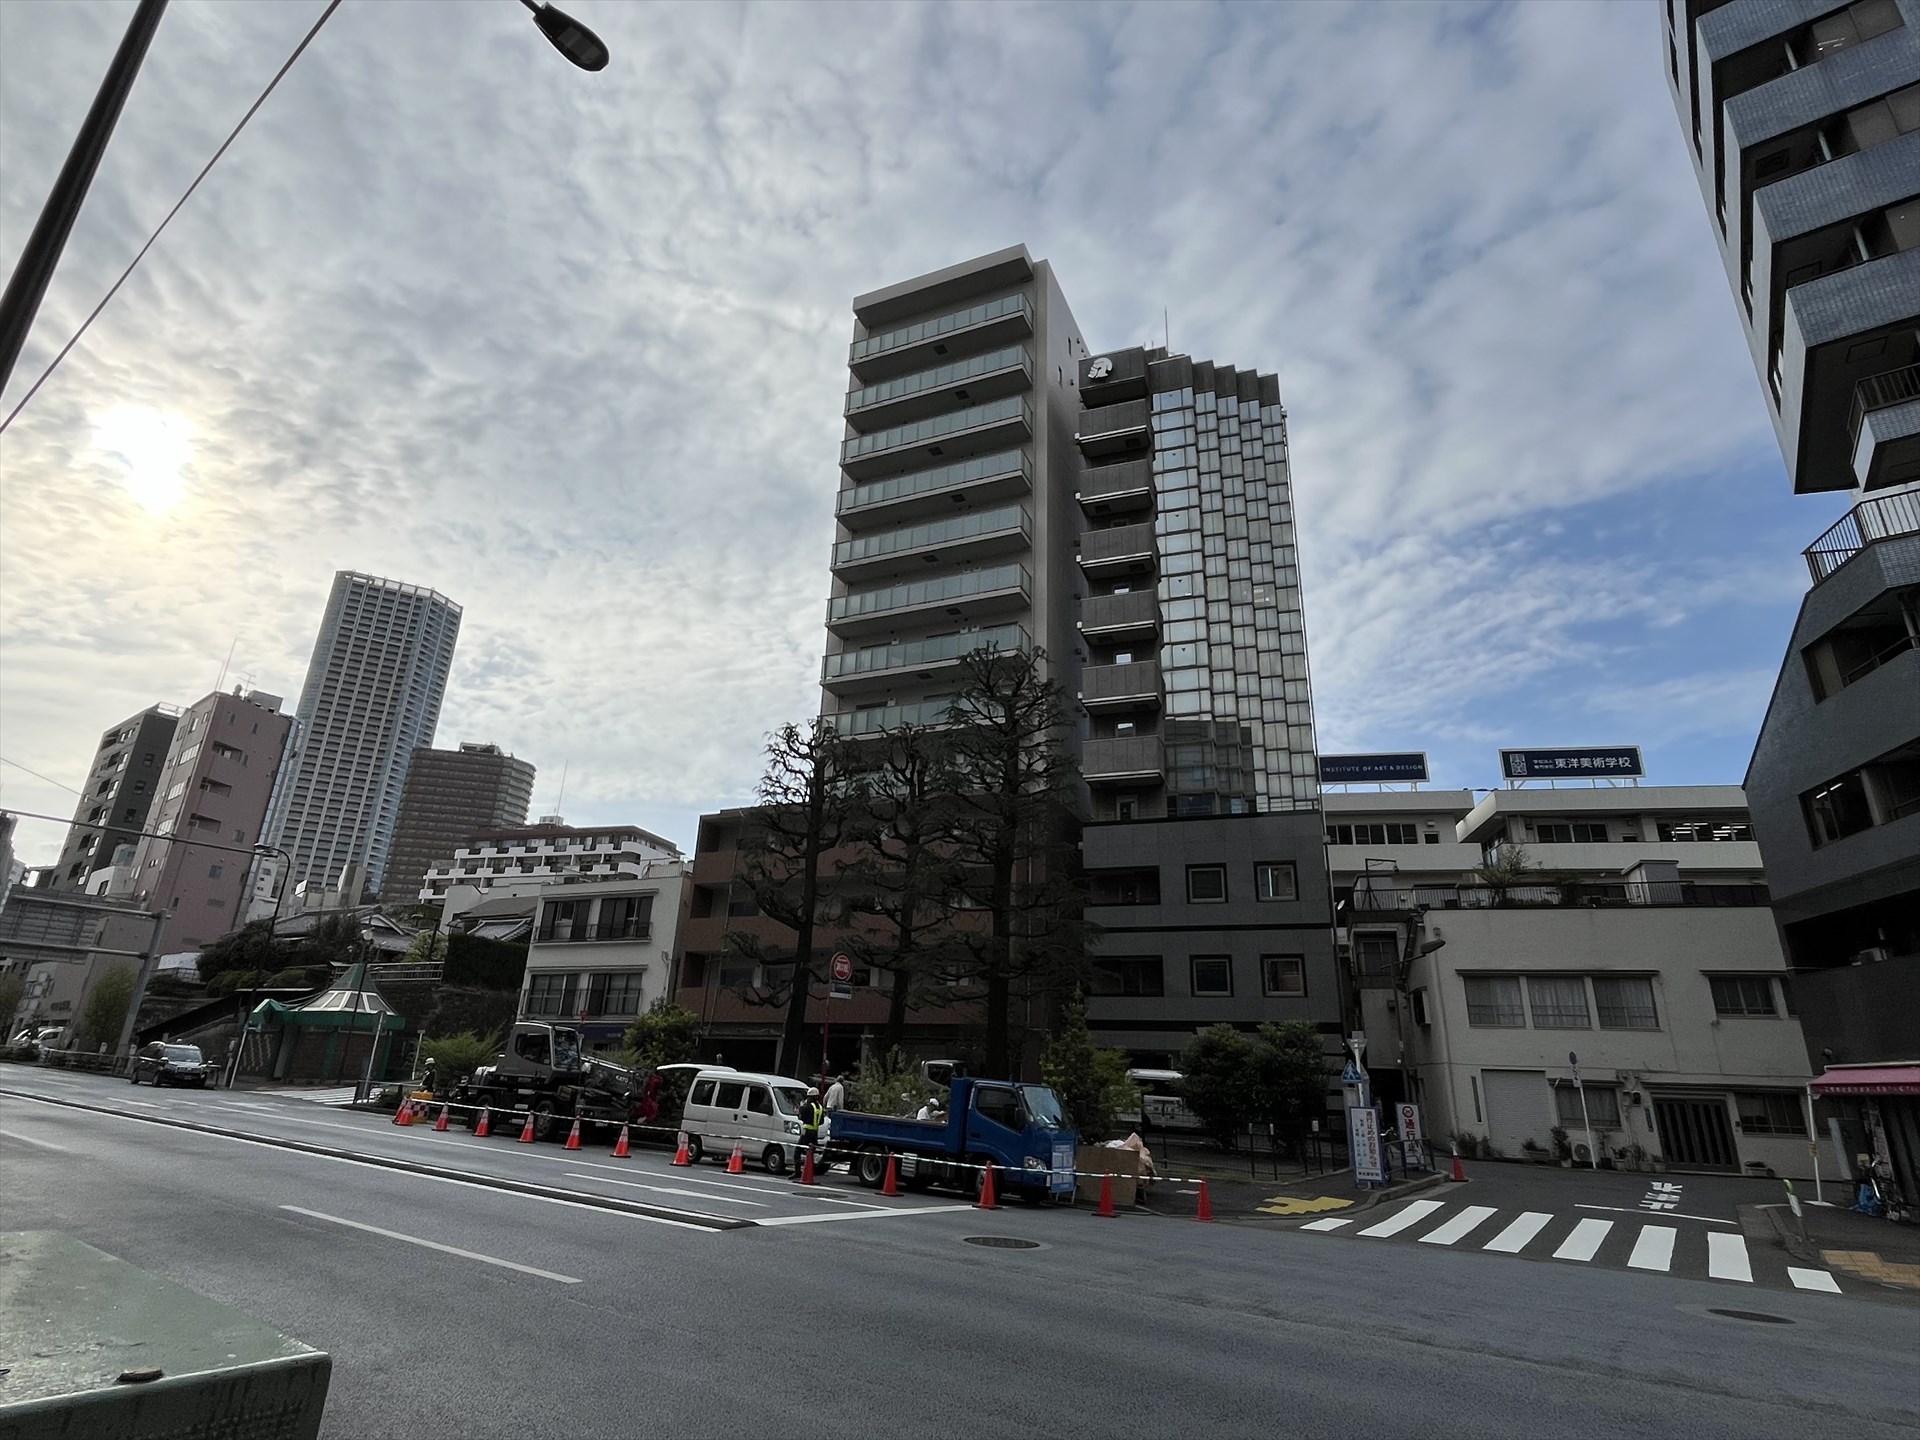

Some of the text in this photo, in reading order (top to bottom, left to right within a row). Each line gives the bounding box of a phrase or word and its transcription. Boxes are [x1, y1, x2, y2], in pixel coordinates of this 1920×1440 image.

[1555, 756, 1633, 769] 東洋美術学校
